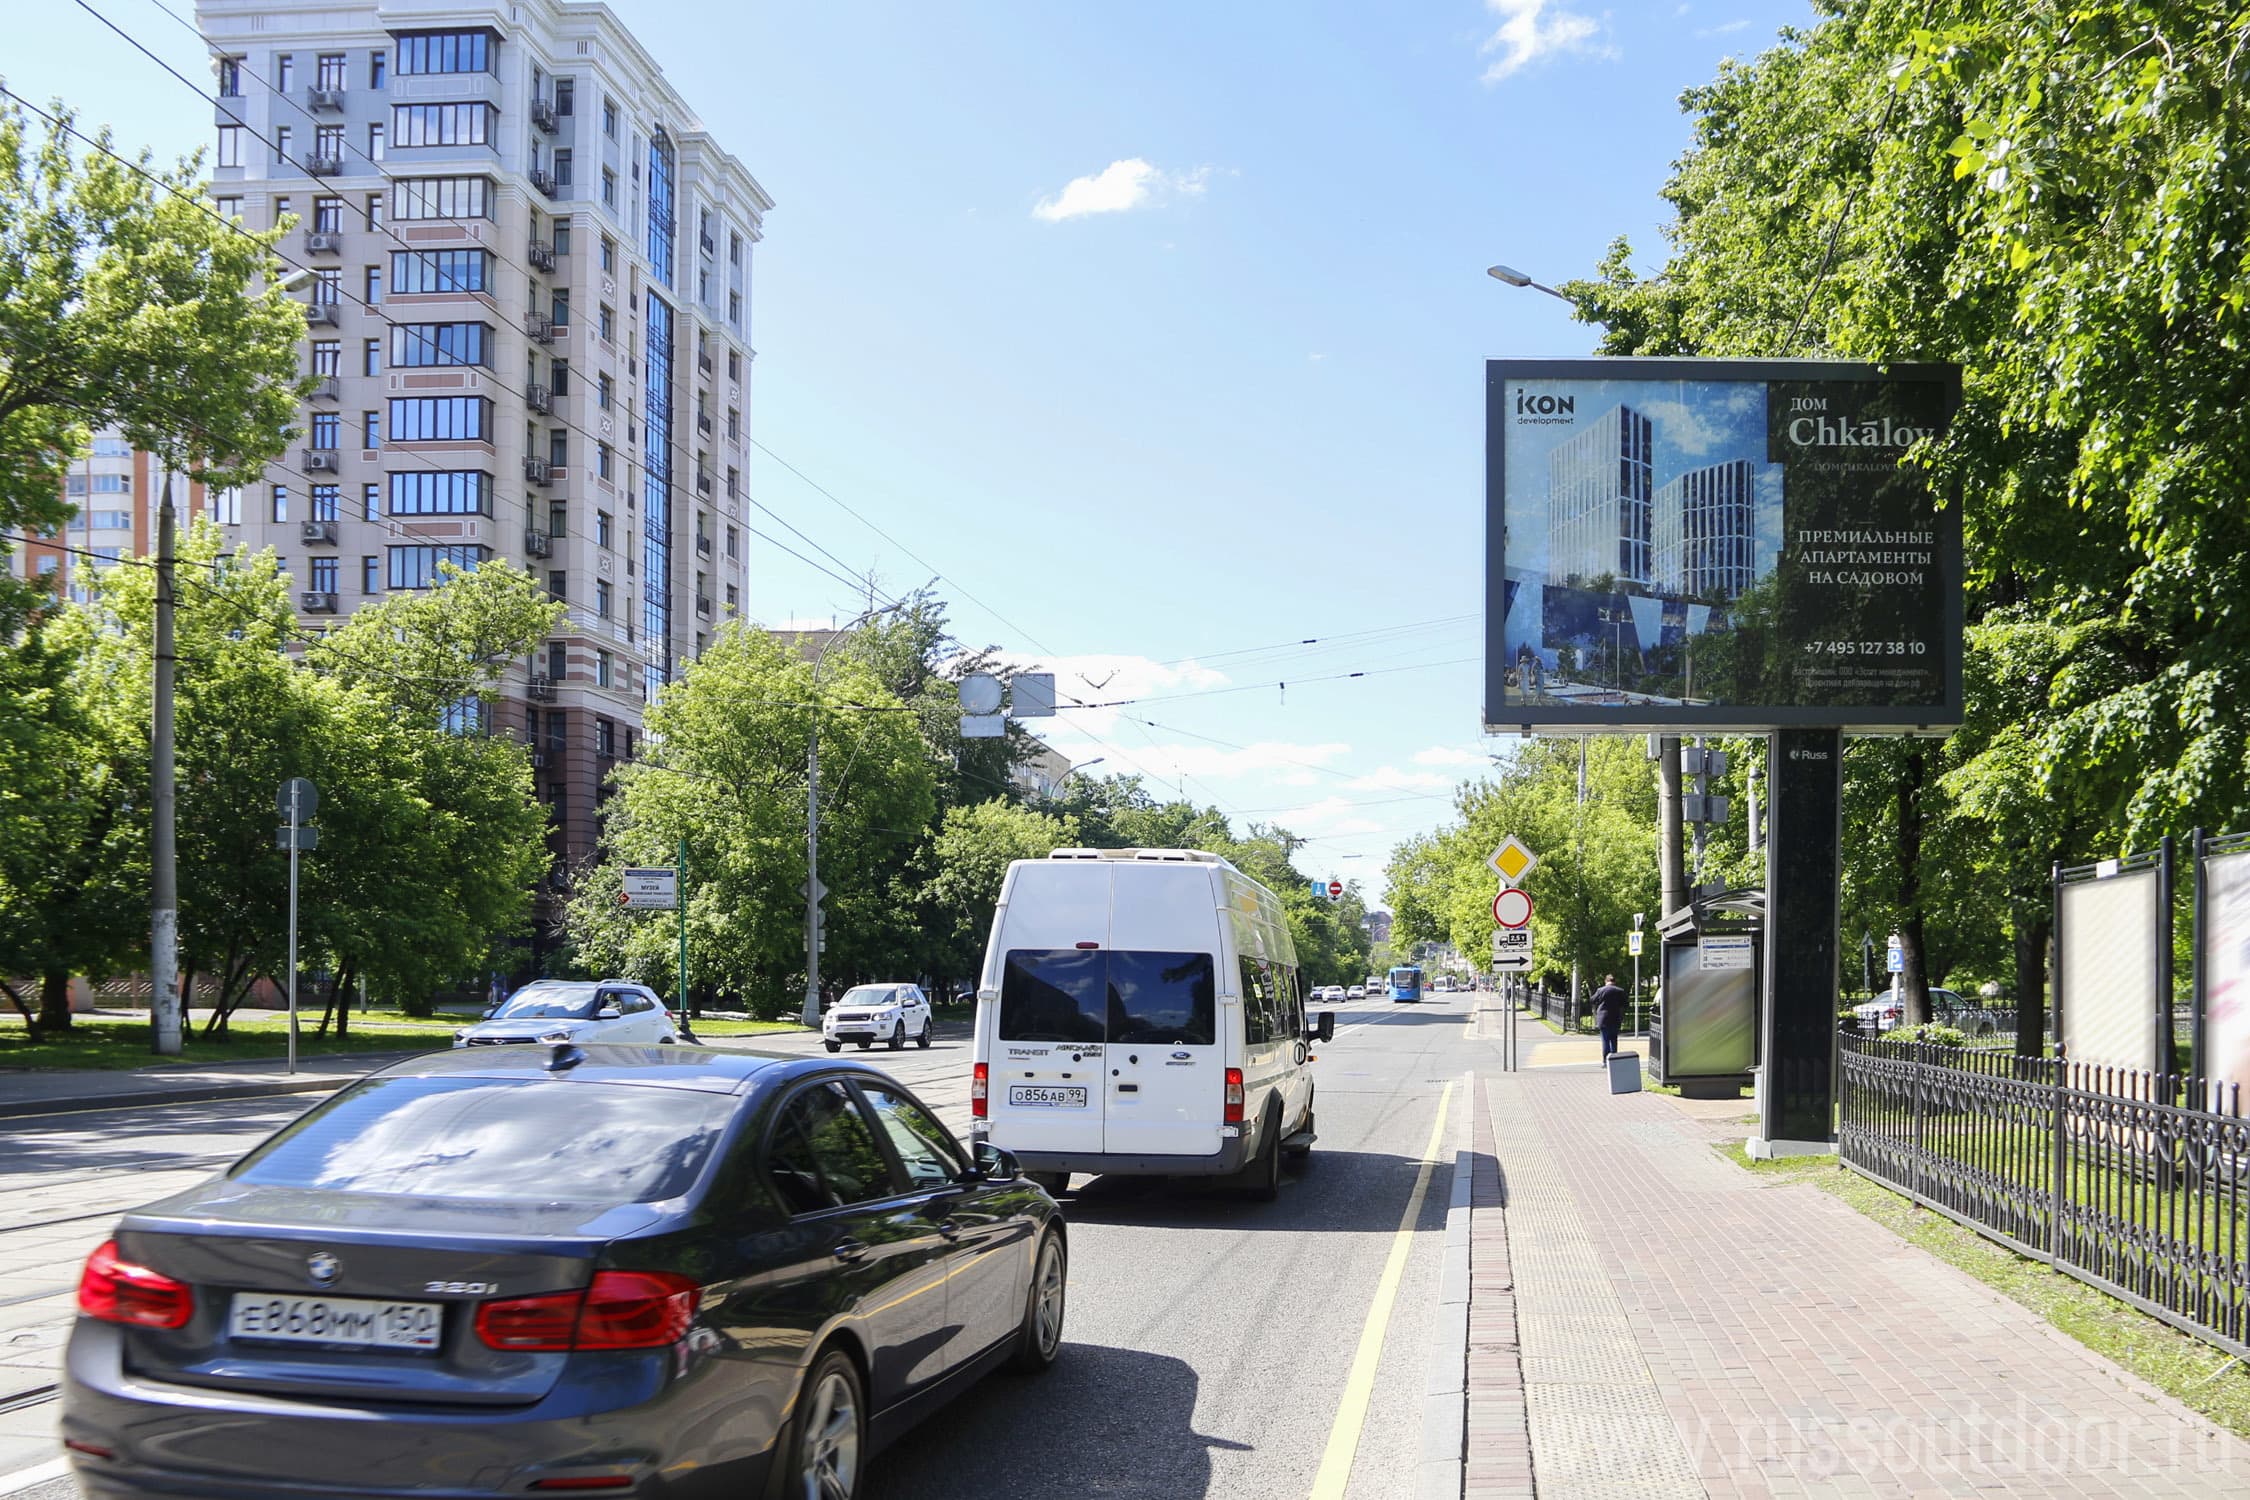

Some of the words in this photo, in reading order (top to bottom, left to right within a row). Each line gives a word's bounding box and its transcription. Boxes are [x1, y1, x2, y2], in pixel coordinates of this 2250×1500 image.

[1790, 397, 1827, 412] ДОМ
[1516, 416, 1575, 425] development
[1799, 530, 1935, 545] ПРЕМИАЛЬНЫЕ
[1800, 551, 1932, 565] АПАРТАМЕНТЫ
[1808, 571, 1833, 584] НА
[1836, 571, 1924, 588] САДОВОМ
[1804, 641, 1823, 655] +7
[1826, 641, 1855, 655] 495
[1858, 641, 1883, 655] 127
[1886, 642, 1905, 655] 38
[1909, 642, 1926, 655] 10
[1801, 750, 1828, 760] Russ
[1008, 1048, 1050, 1056] TRANSIT
[381, 1304, 434, 1333] 150
